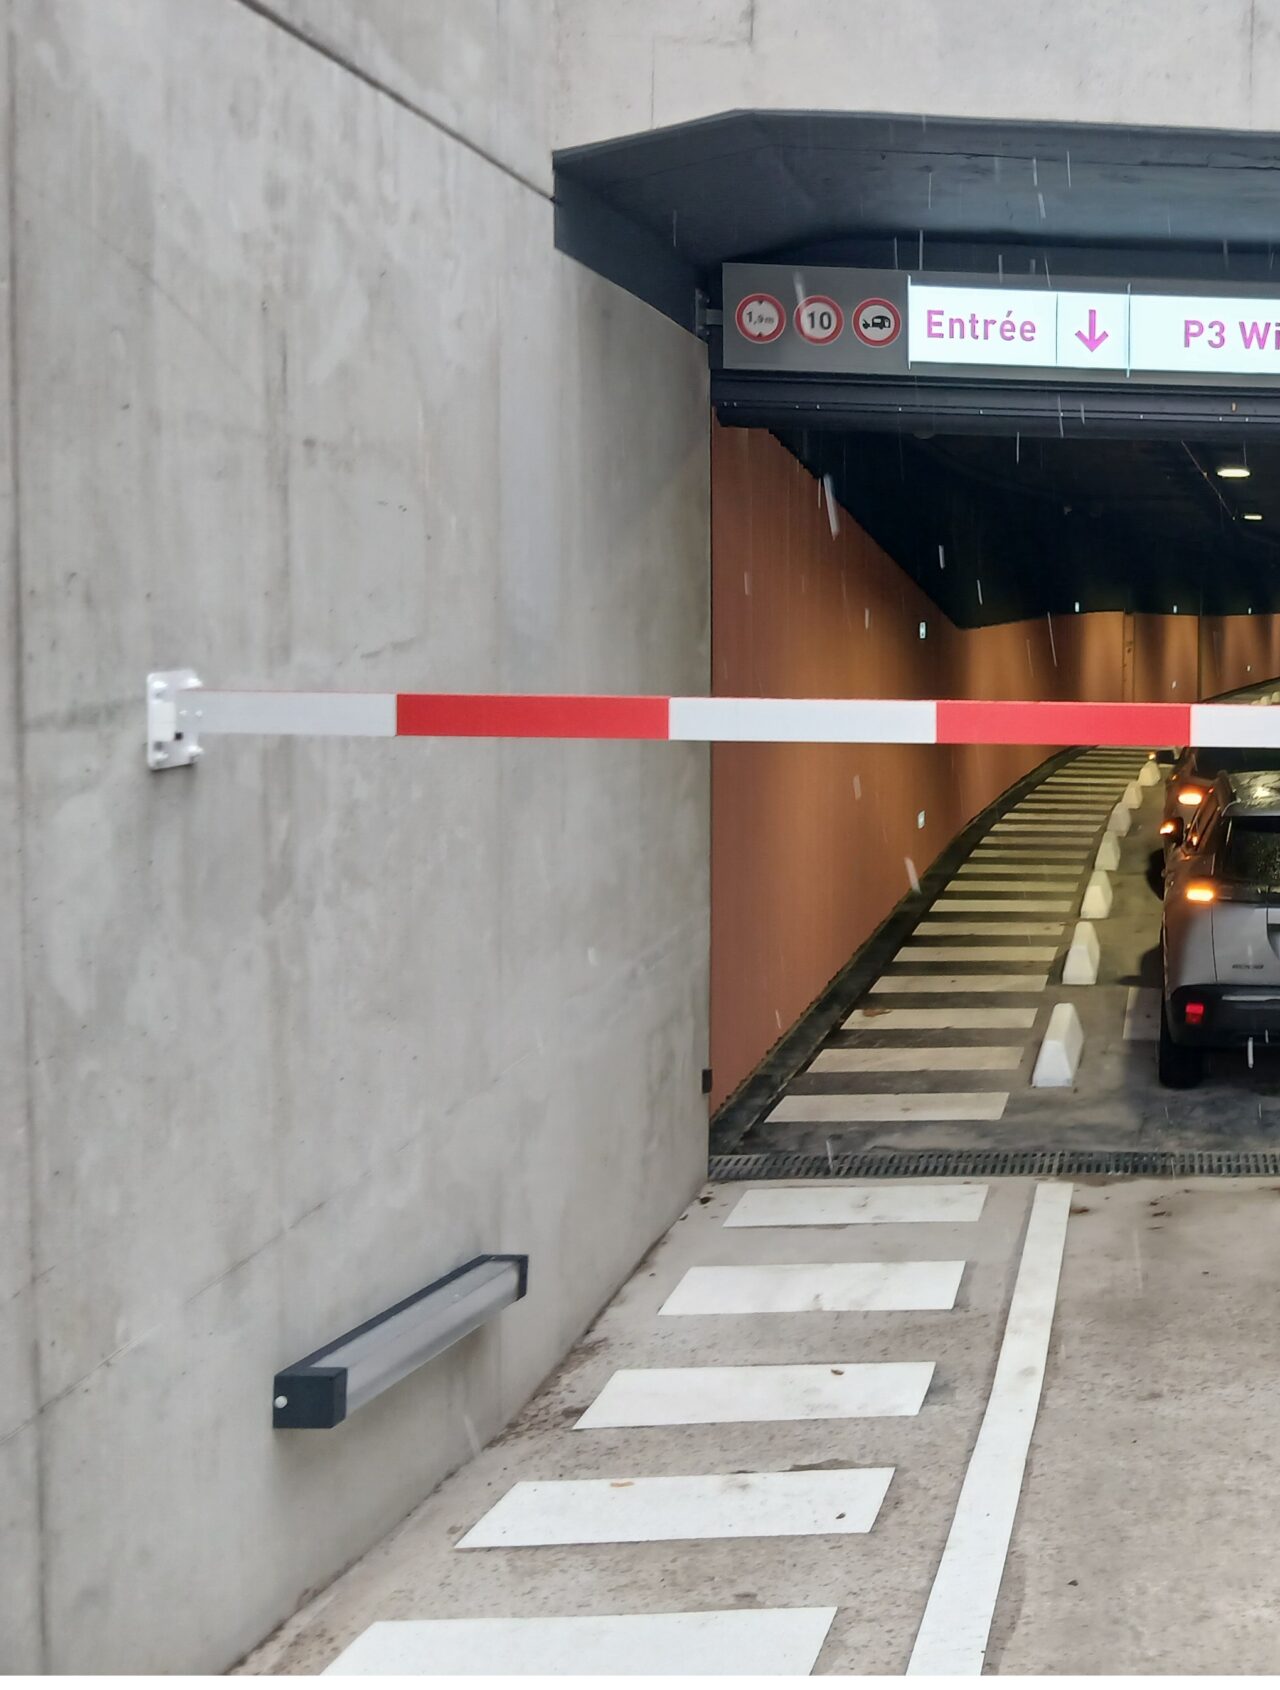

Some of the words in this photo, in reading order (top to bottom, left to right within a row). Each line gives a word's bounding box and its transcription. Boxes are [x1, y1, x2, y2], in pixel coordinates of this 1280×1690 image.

[808, 311, 832, 331] 10
[927, 309, 1036, 342] Entrée
[1184, 319, 1226, 349] P3
